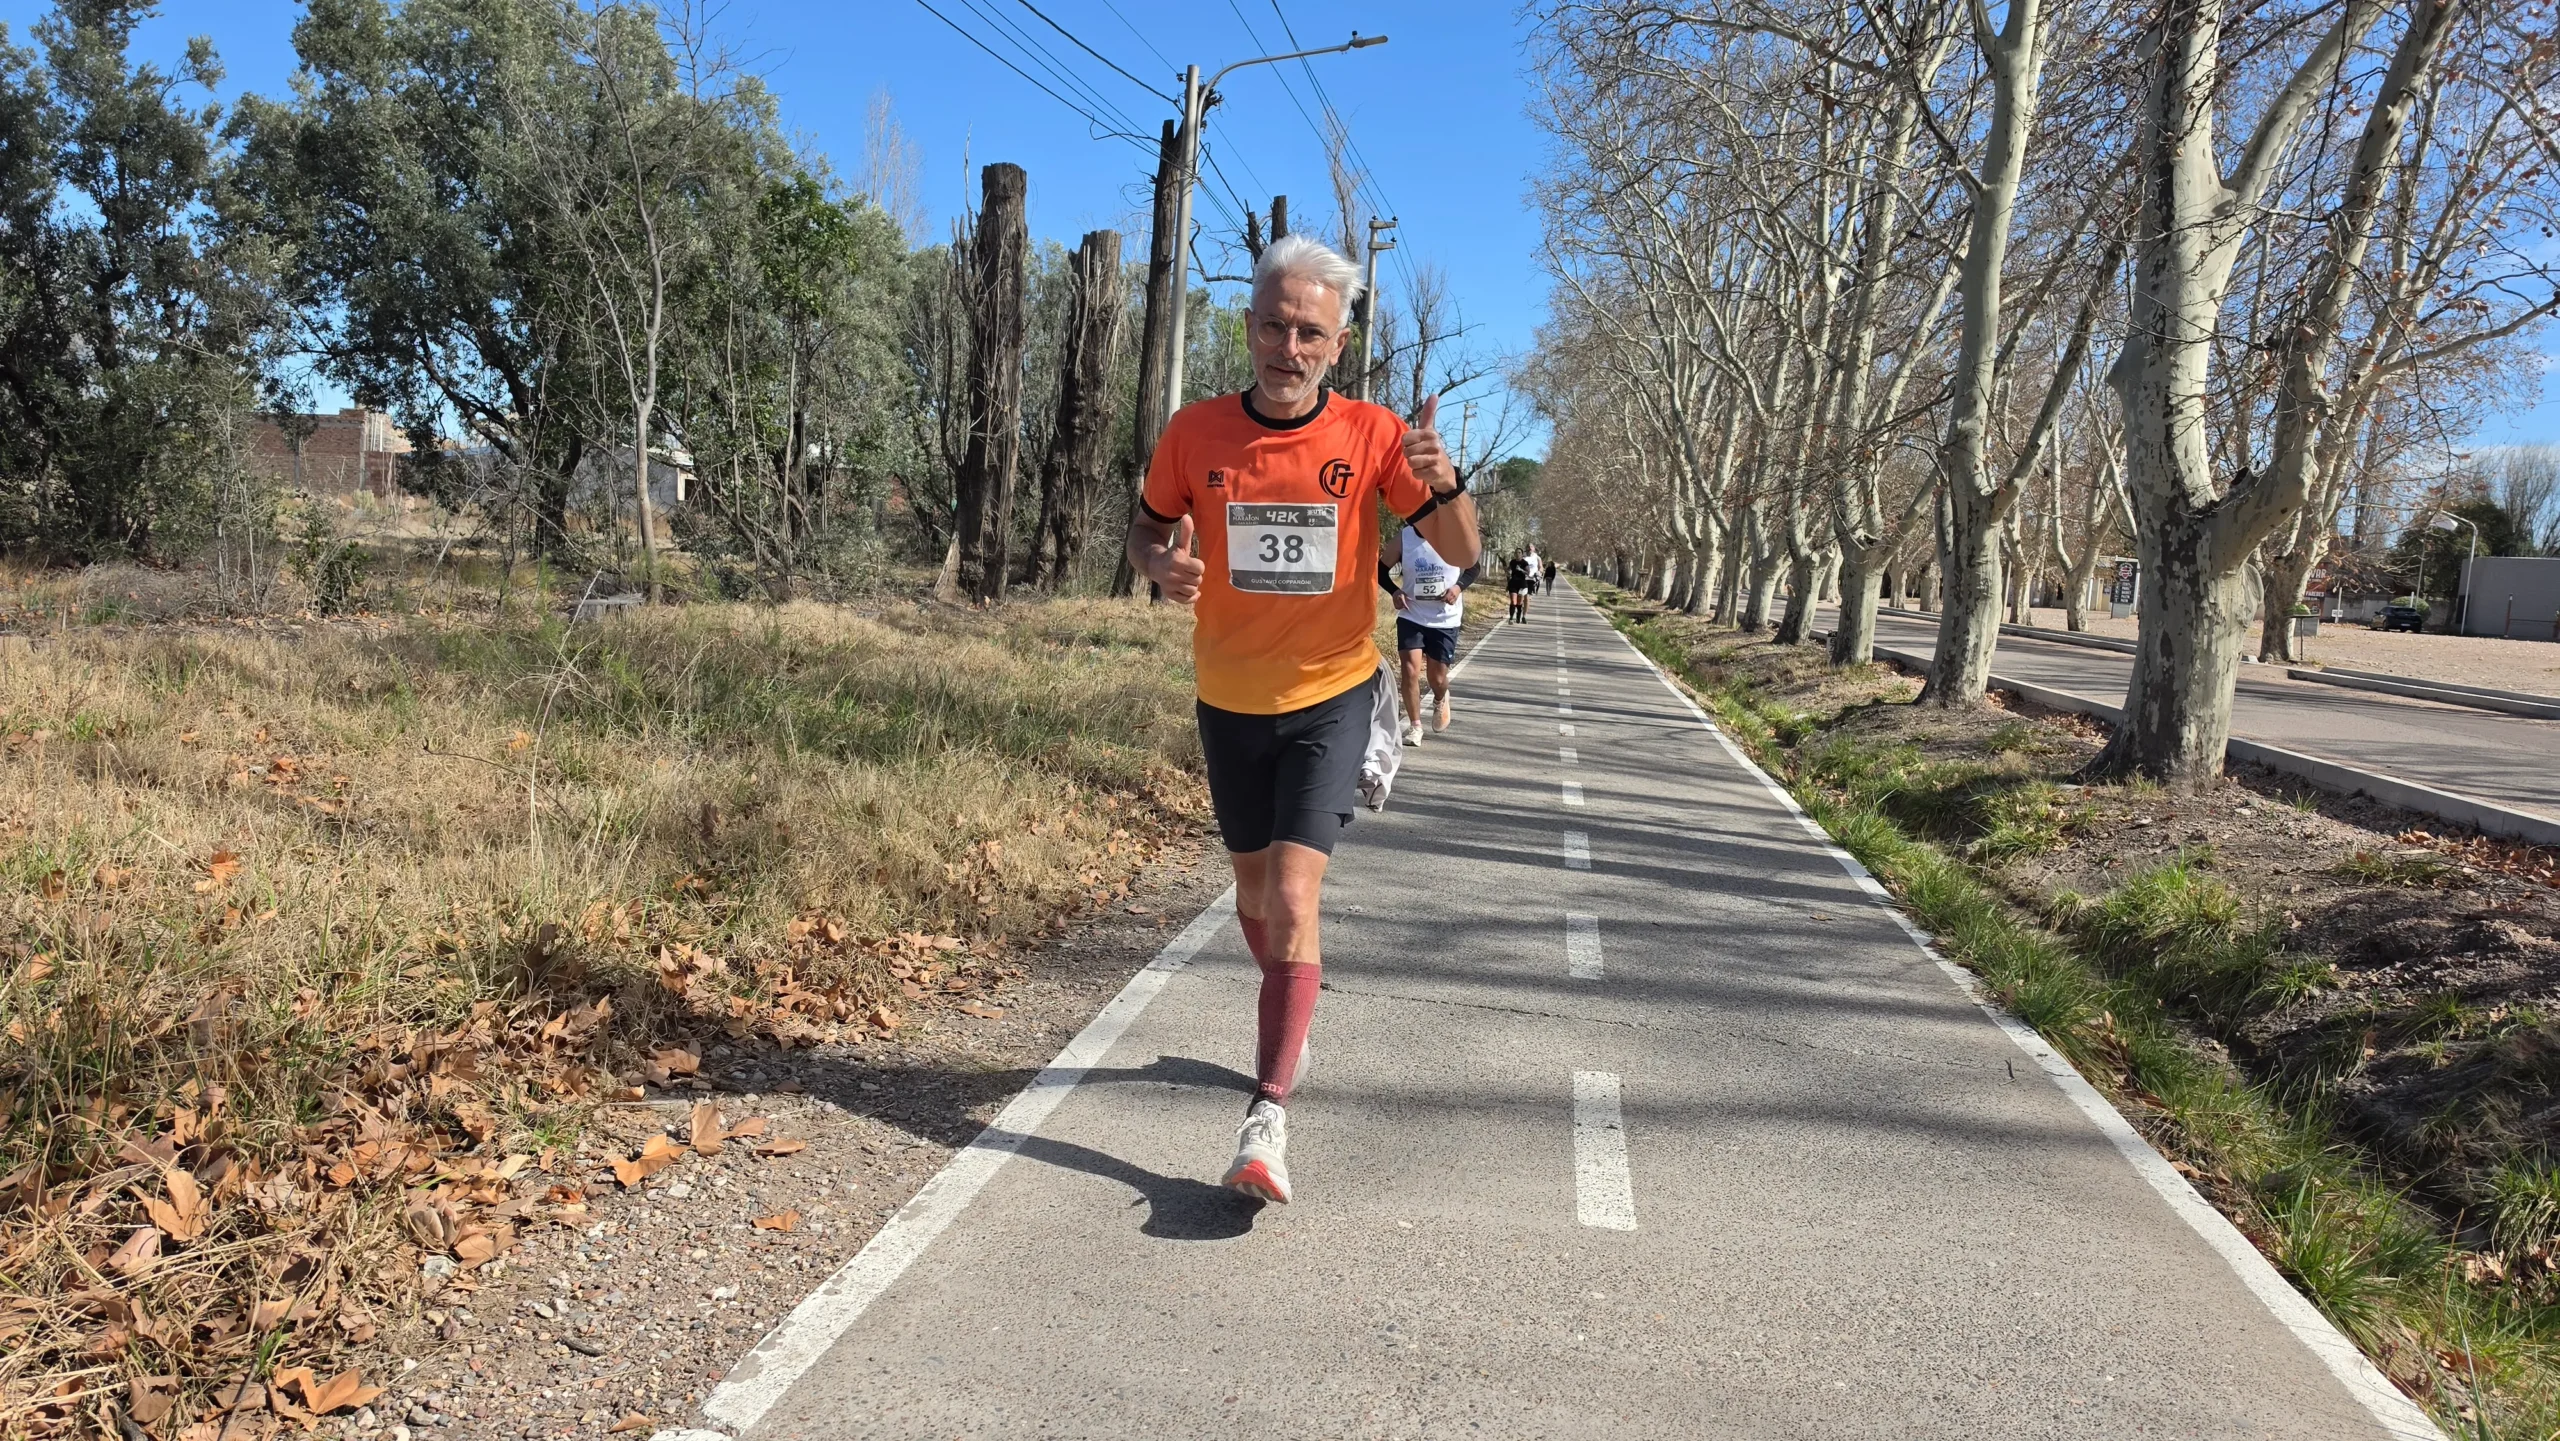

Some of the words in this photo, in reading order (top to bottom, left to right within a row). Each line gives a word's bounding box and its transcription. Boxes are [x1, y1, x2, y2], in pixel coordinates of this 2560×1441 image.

[1266, 511, 1300, 523] 42K
[1259, 534, 1304, 563] 38
[1423, 585, 1436, 594] 52
